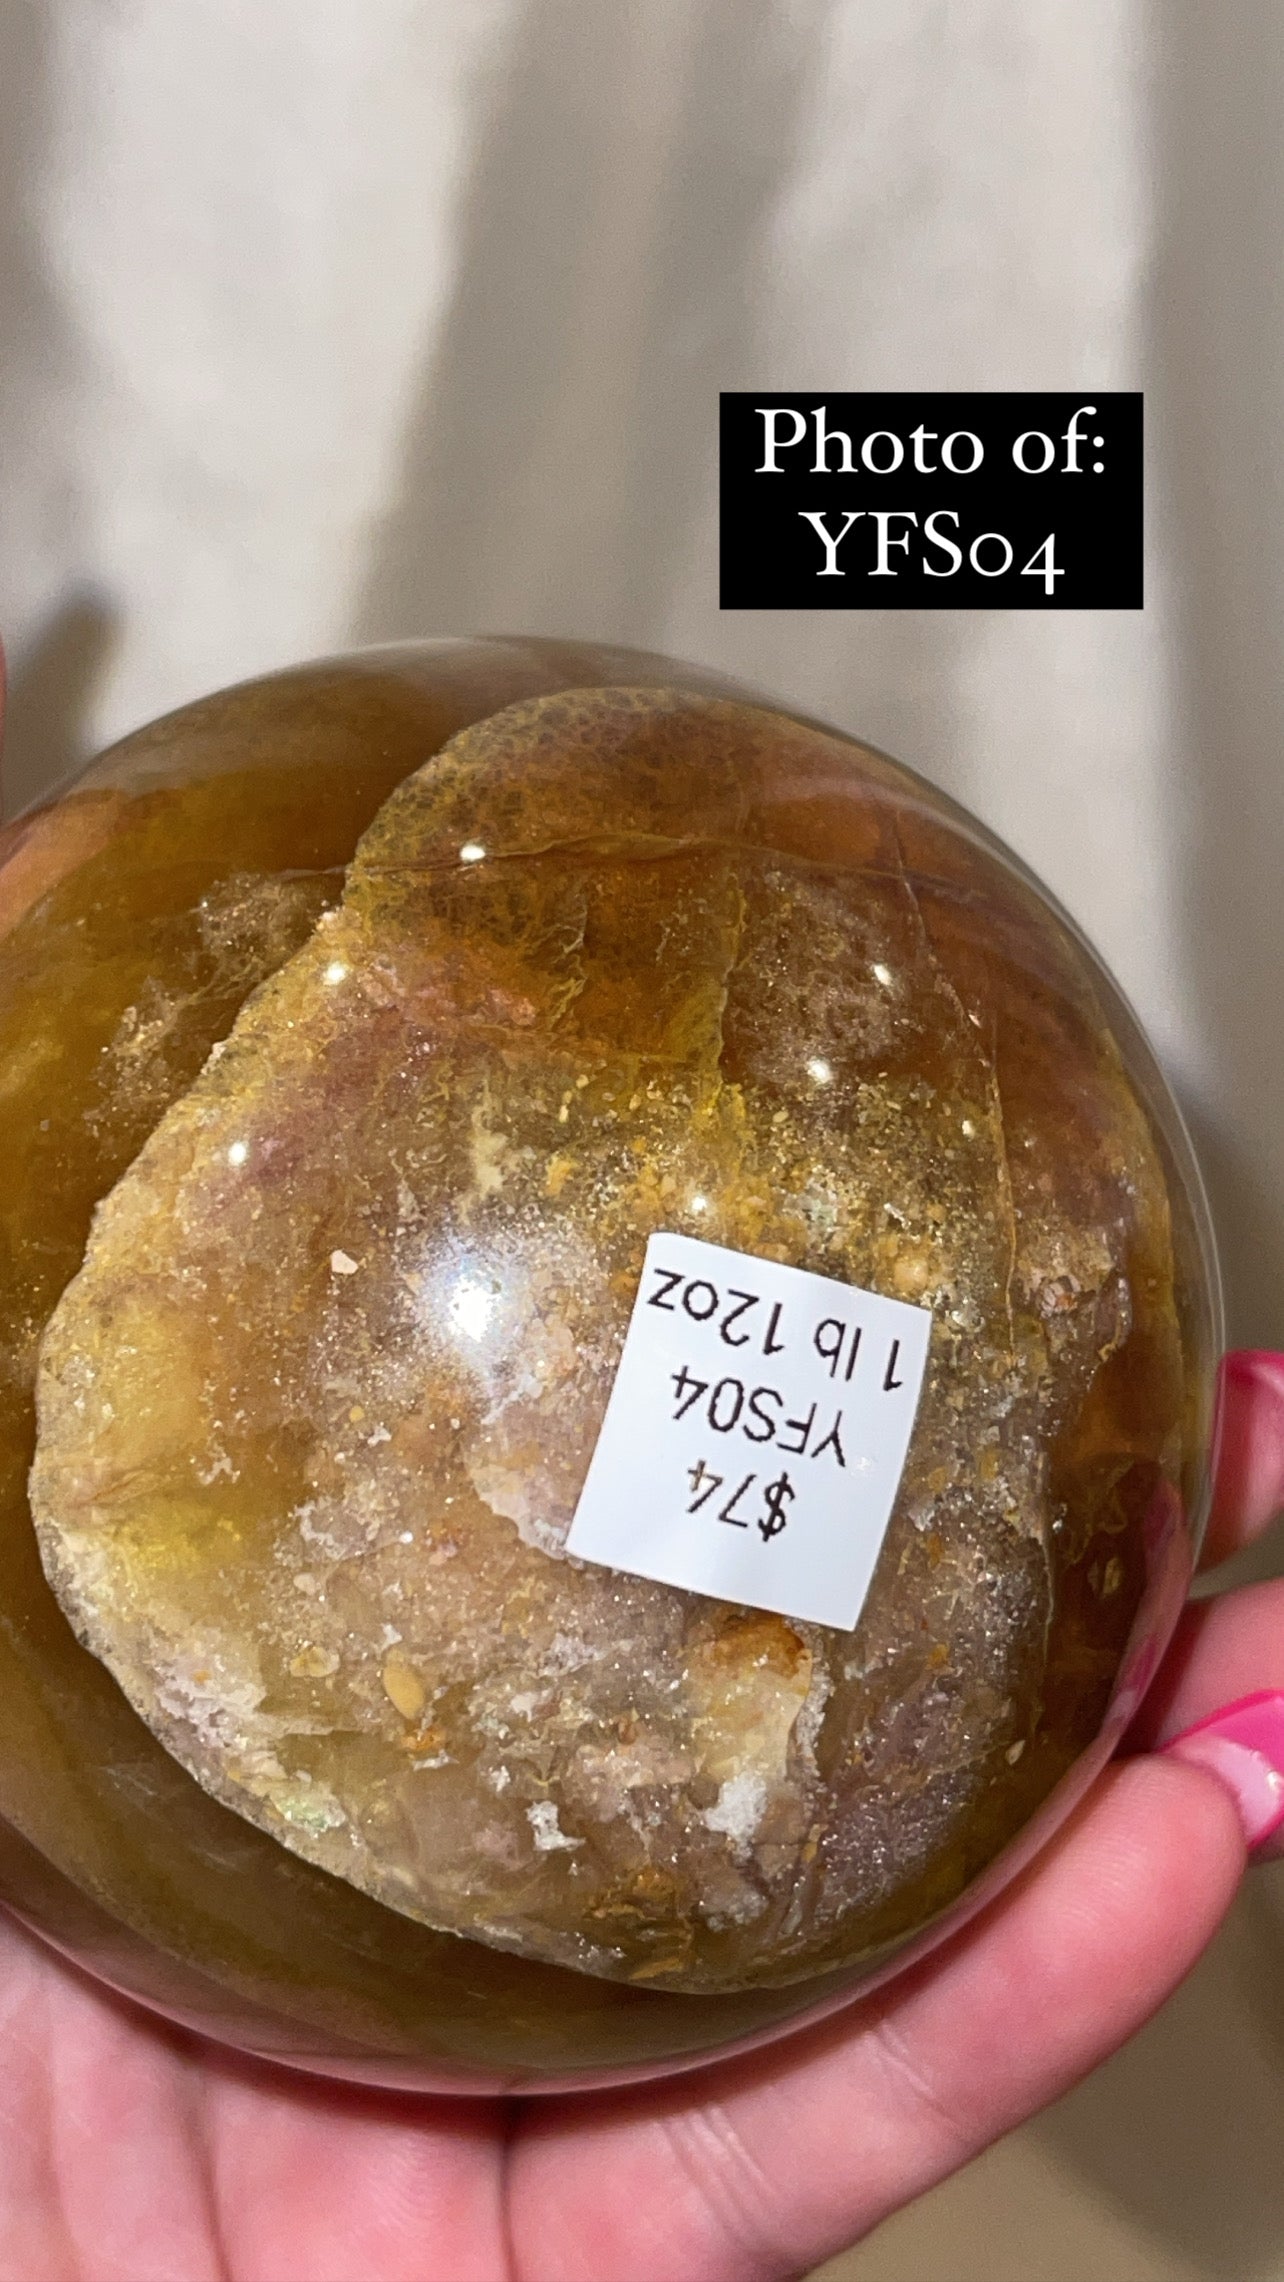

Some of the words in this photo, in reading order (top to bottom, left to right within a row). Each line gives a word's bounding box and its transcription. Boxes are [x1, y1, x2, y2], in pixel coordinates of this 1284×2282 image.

[647, 1268, 786, 1356] 12oz
[813, 1318, 862, 1382] lb
[883, 1339, 903, 1392] 1
[671, 1365, 846, 1467] YFS04
[687, 1460, 796, 1542] $74
